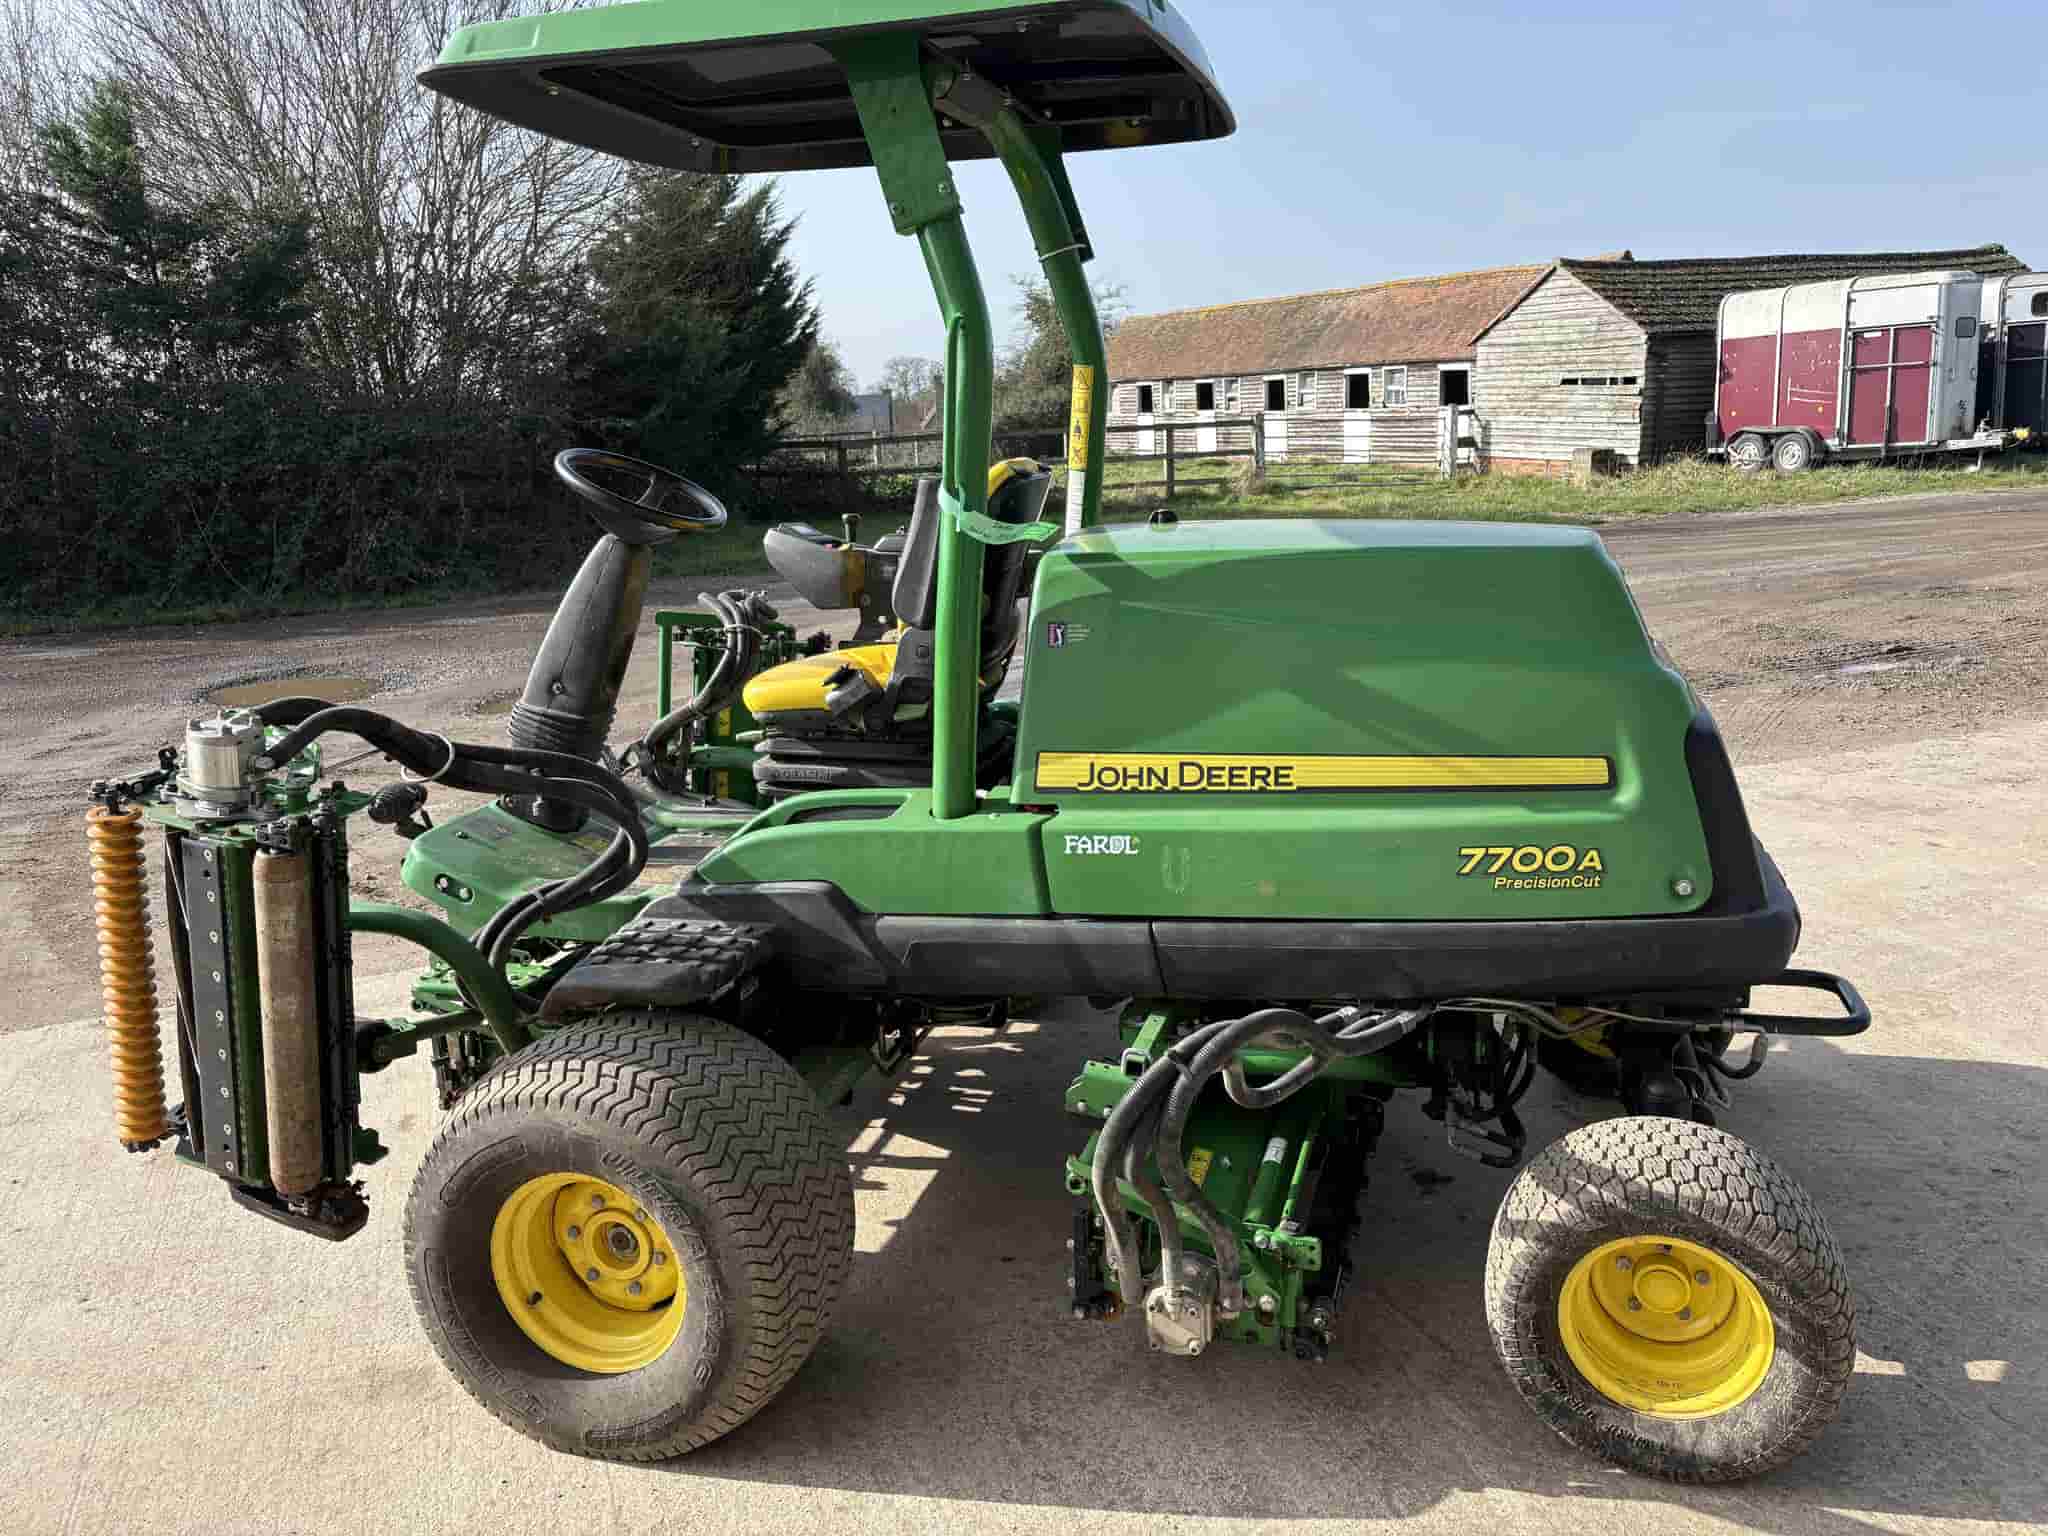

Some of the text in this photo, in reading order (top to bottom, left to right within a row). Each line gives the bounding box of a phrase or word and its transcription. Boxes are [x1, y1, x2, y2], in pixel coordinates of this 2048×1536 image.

[1077, 760, 1295, 788] JOHN DEERE
[1063, 834, 1139, 855] FAROL
[1456, 845, 1604, 874] 7700A
[1493, 875, 1601, 889] PrecisionCut
